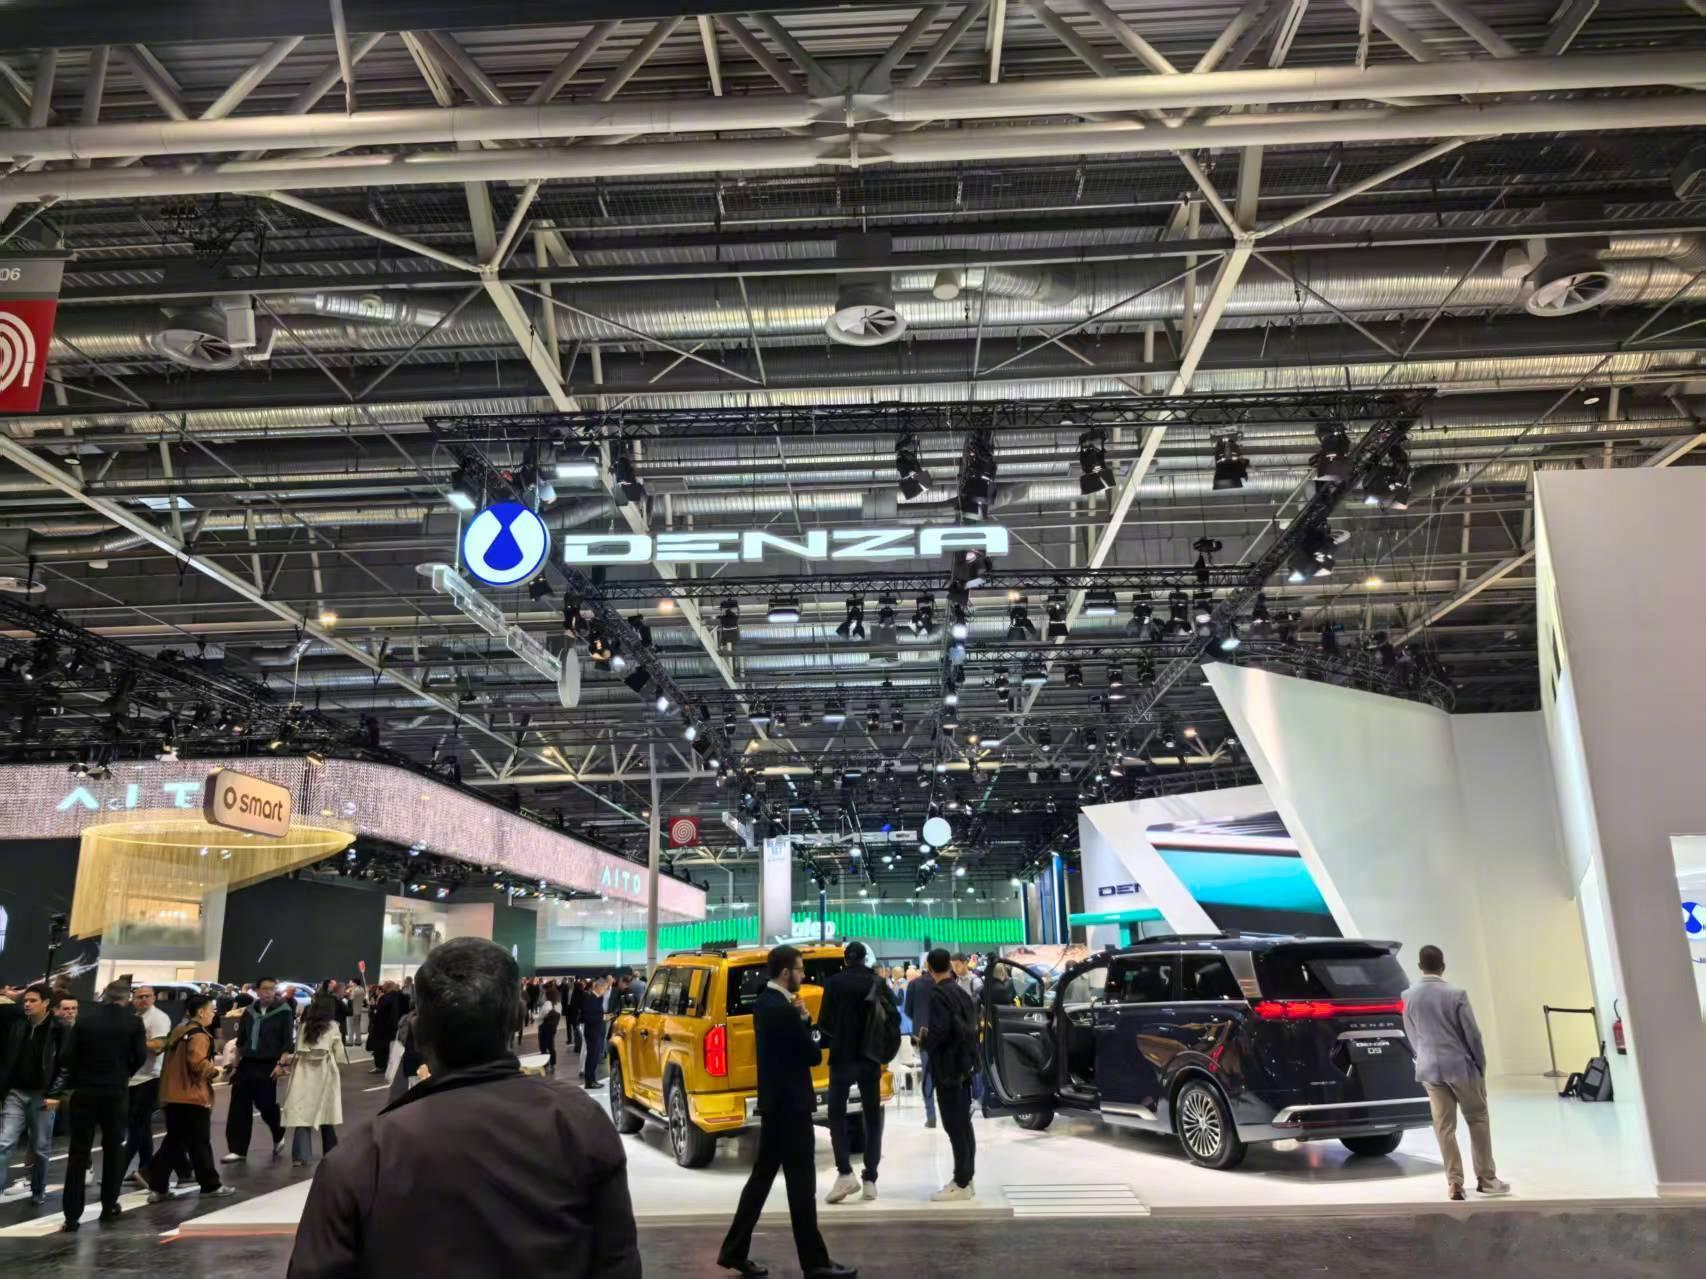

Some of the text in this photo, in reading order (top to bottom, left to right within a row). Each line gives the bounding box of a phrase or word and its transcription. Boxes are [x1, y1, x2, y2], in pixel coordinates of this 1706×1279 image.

[563, 526, 1009, 563] DENZA
[56, 781, 202, 811] AIT
[239, 793, 284, 823] smart
[602, 864, 641, 896] AITO
